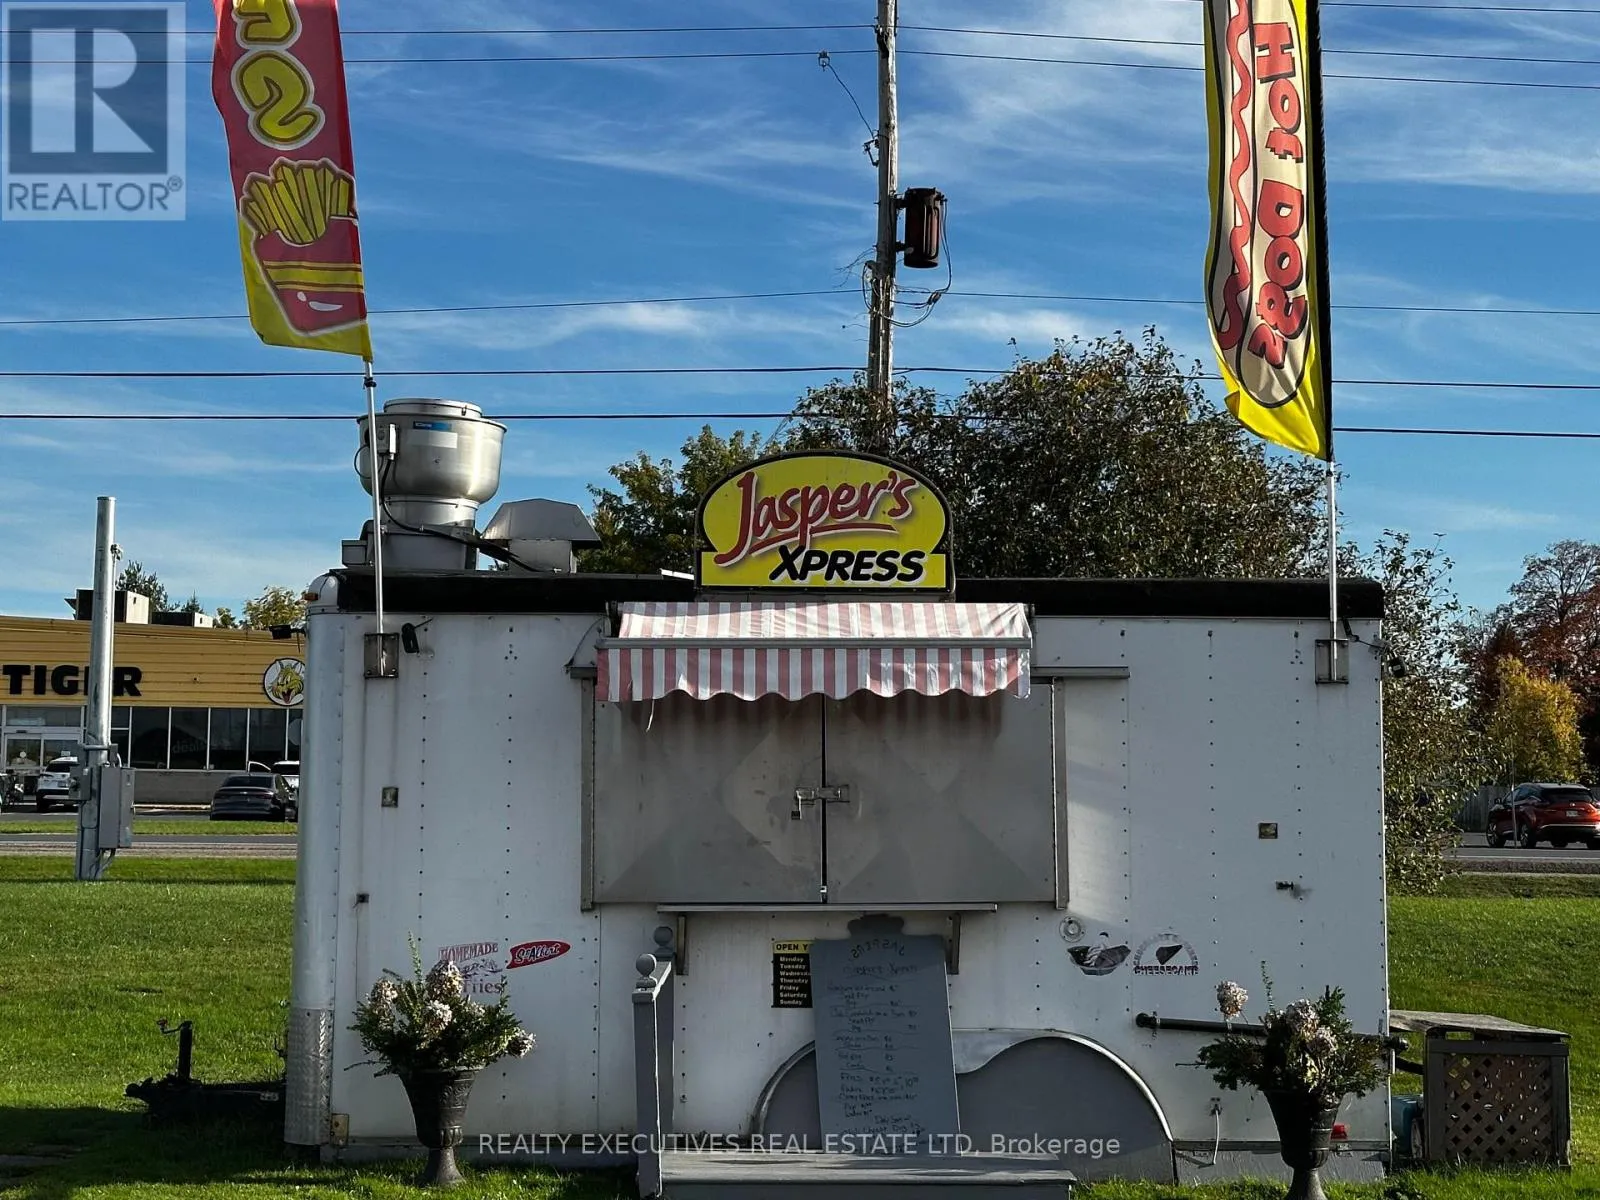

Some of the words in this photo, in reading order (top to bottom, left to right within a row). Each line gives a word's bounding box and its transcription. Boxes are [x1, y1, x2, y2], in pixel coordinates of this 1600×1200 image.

[713, 471, 919, 567] Jasper's
[769, 545, 927, 584] XPRESS
[3, 664, 142, 697] TIGR
[437, 942, 499, 964] HOMEMADE
[776, 943, 799, 951] OPEN
